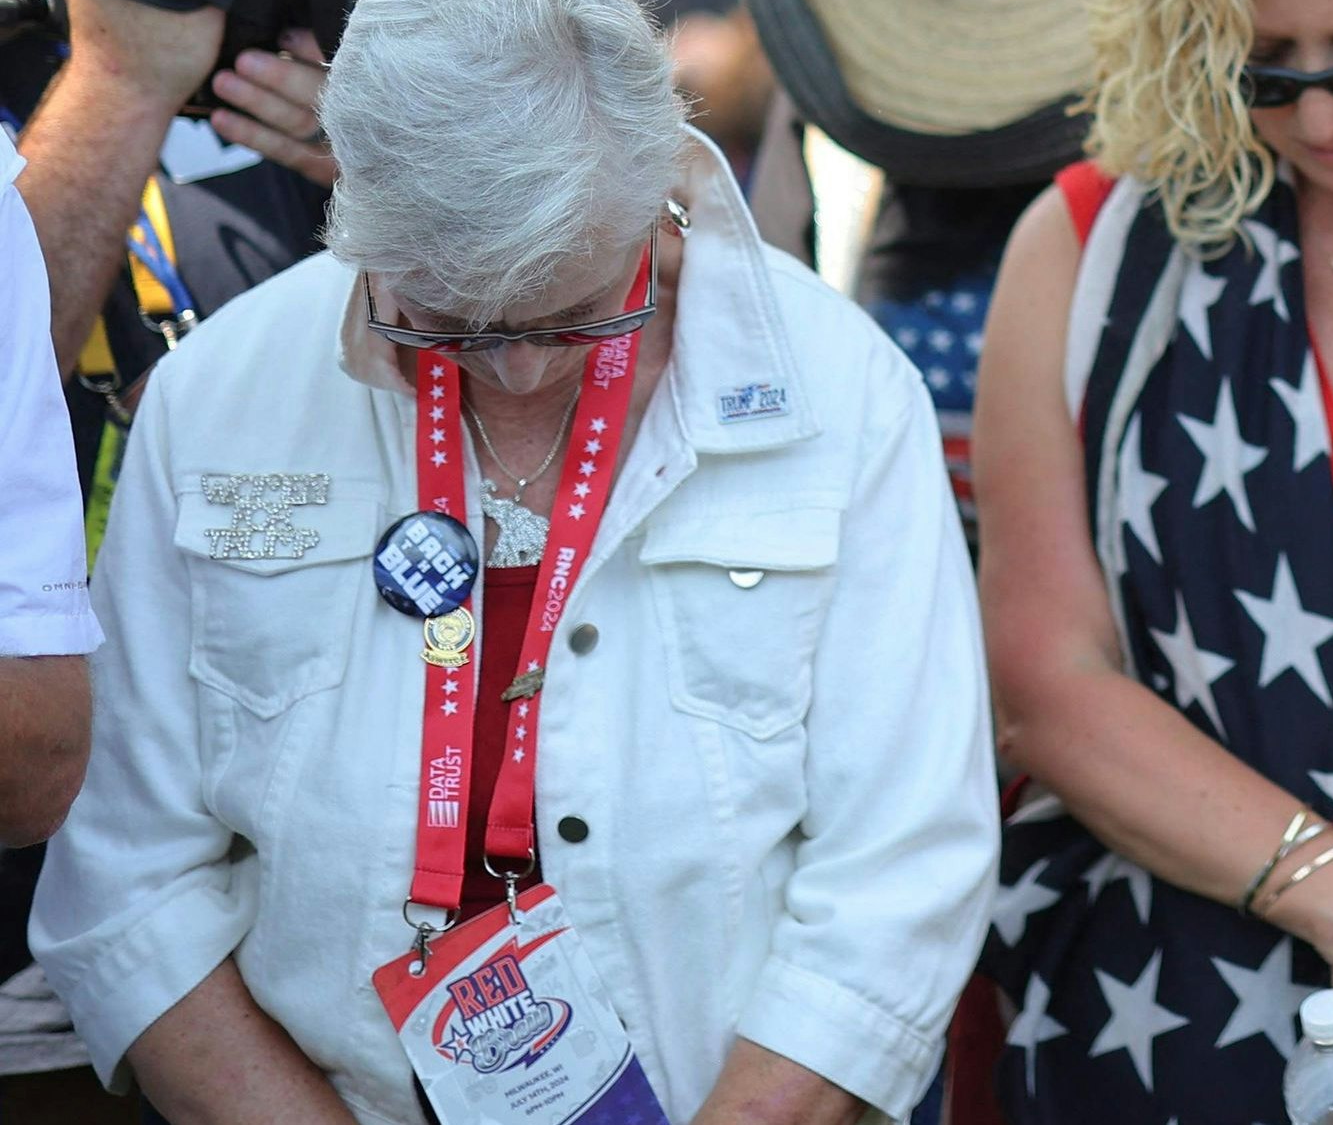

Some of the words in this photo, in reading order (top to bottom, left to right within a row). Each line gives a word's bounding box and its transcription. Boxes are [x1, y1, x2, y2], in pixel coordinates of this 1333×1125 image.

[592, 338, 618, 391] TRUST
[609, 335, 632, 379] DATA
[203, 529, 320, 559] TRUMP
[401, 538, 450, 595] THE
[405, 519, 470, 591] BACK
[377, 543, 444, 616] BLUE
[540, 546, 577, 632] RNC2024
[429, 757, 446, 800] DATA
[445, 744, 462, 800] TRUST
[449, 955, 526, 1019] RED
[464, 989, 536, 1036] WHITE
[470, 1003, 549, 1070] Brew
[510, 1096, 528, 1110] JULY
